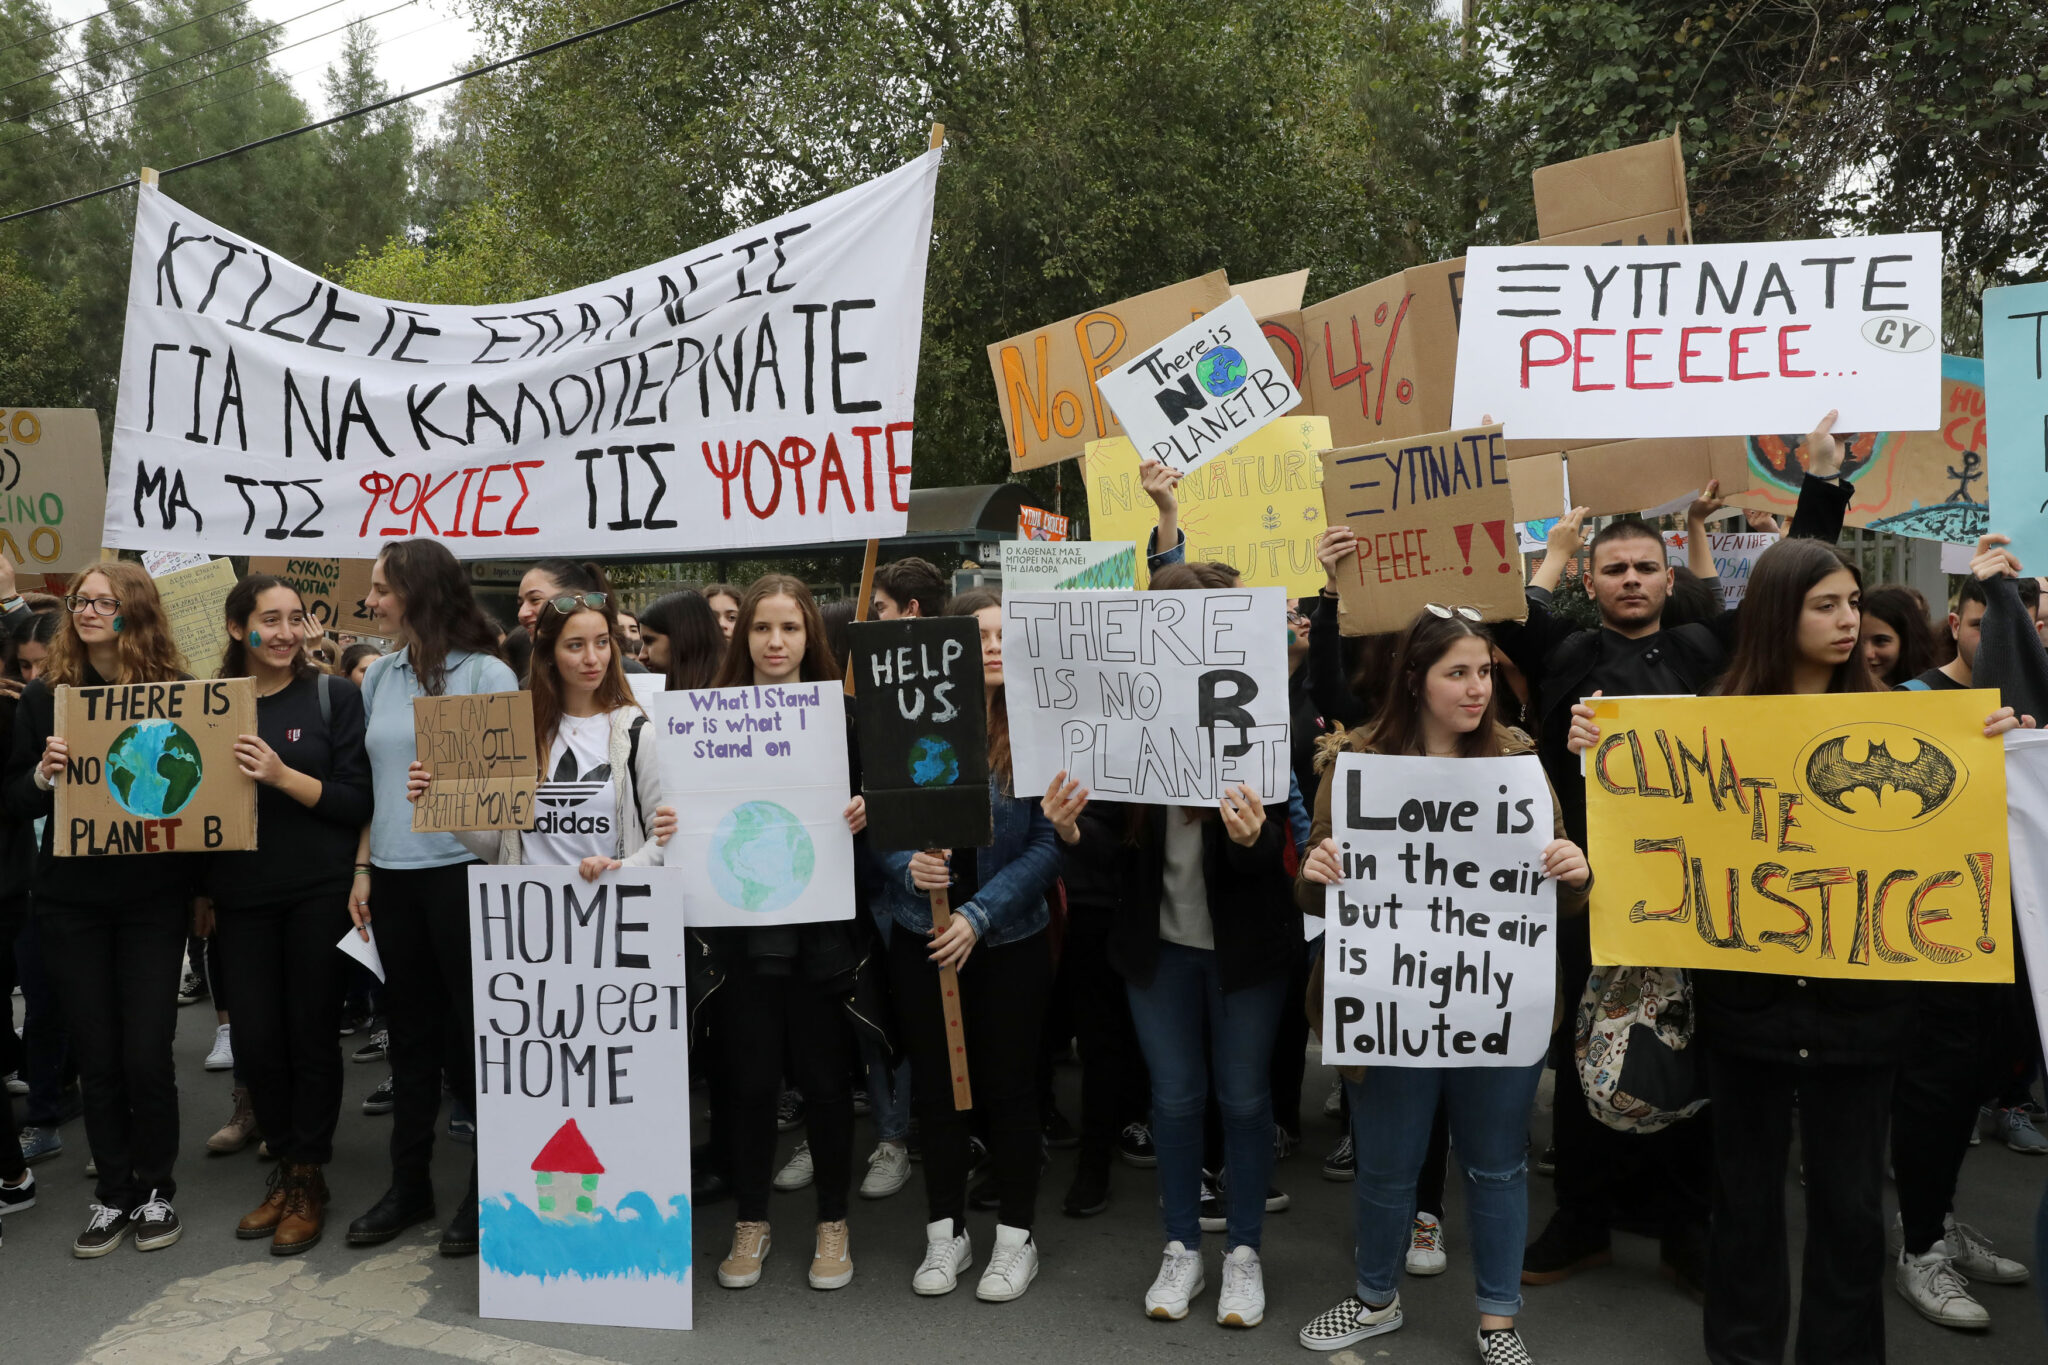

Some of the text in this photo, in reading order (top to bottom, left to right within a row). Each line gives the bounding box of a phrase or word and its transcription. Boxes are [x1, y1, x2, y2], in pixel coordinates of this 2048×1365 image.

[1496, 254, 1913, 321] ΞΥΠΝΑΤΕ
[1127, 339, 1209, 386] There
[1208, 324, 1232, 345] is
[1875, 319, 1922, 348] CY
[145, 299, 882, 462] ΓΙΑ ΝΑ ΚΑΛΟΠΕΡΝΑΤΕ
[999, 336, 1084, 459] No
[1150, 369, 1291, 467] PLANET B
[134, 459, 204, 532] ΜΑ
[224, 474, 325, 540] ΤΙΣ
[575, 443, 678, 531] ΤΙΣ
[702, 421, 914, 520] ΨΟΦΑΤΕ
[1177, 450, 1324, 504] NATURE
[1336, 433, 1509, 518] ΞΥΠΝΑΤΕ
[1005, 556, 1086, 565] ΜΠΟΡΕΙ ΝΑ ΚΑΝΕΙ
[1005, 564, 1059, 574] ΤΗ ΔΙΑΦΟΡΑ
[1006, 547, 1081, 556] Ο ΚΑΘΕΝΑΣ ΜΑΣ
[1009, 594, 1253, 667] THERE
[871, 639, 963, 687] HELP
[80, 682, 230, 721] THERE IS
[413, 695, 519, 734] WE CAN'T
[668, 709, 806, 736] for is what I
[689, 685, 820, 712] What I Stand
[898, 682, 961, 724] US
[1034, 667, 1259, 757] IS NO B
[66, 757, 101, 786] NO
[416, 727, 528, 764] DRINK OIL
[765, 739, 791, 757] on
[1061, 719, 1288, 800] PLANET
[457, 760, 522, 795] CAN'T
[1346, 769, 1534, 834] Love is
[1595, 725, 1816, 853] CLIMATE
[70, 815, 223, 856] PLANET B
[414, 792, 474, 829] BREATHE
[1341, 842, 1547, 896] in the air
[480, 880, 651, 969] HOME
[1337, 890, 1548, 947] but the air
[1628, 836, 1997, 966] JUSTICE!
[1339, 938, 1513, 1009] is highly
[1334, 996, 1512, 1058] Polluted
[479, 1035, 634, 1108] HOME
